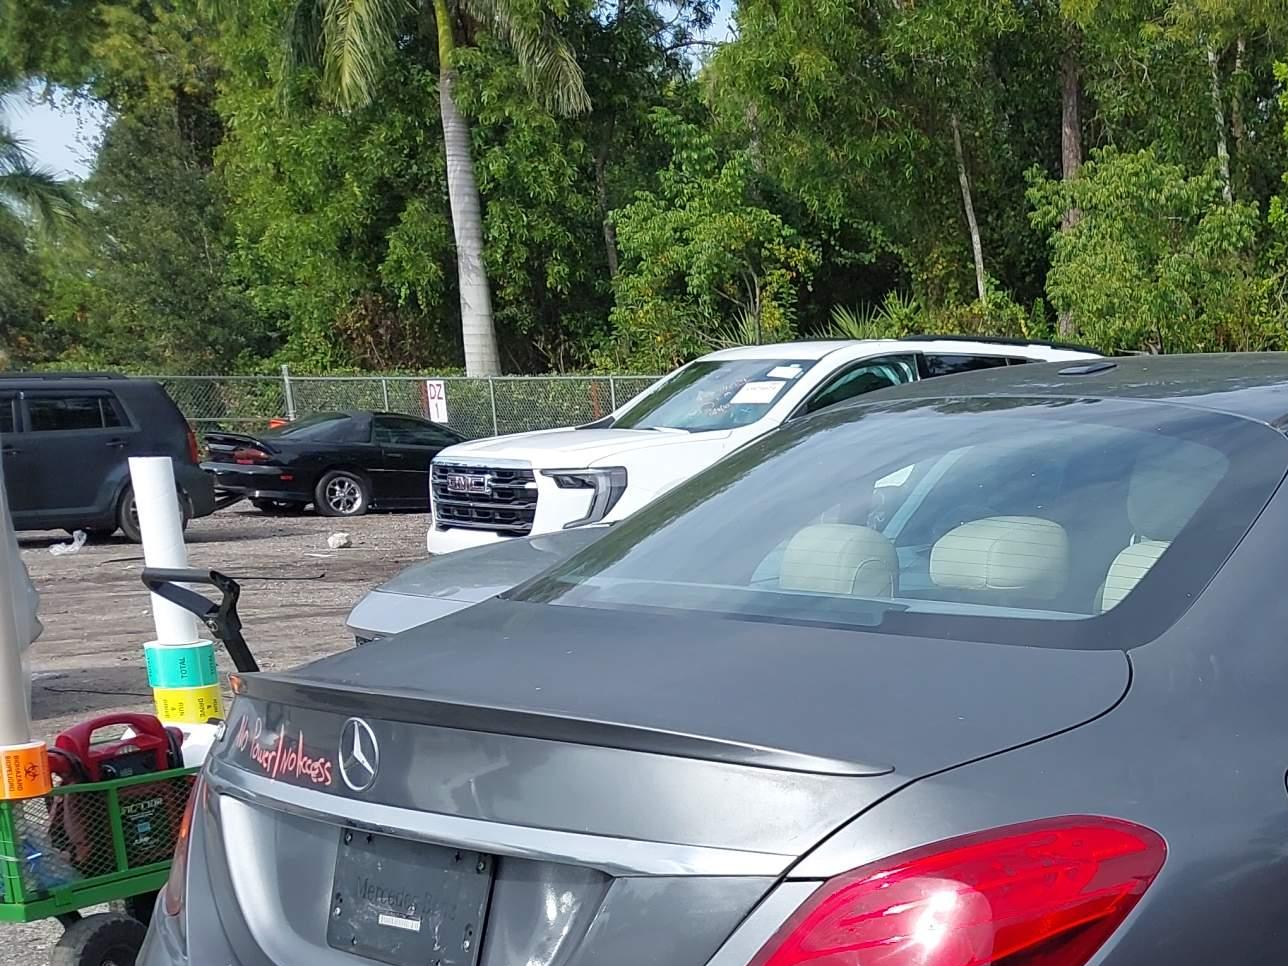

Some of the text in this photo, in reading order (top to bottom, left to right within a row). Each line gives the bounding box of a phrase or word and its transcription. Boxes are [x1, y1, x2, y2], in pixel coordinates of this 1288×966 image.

[429, 383, 444, 400] DZ
[447, 474, 486, 493] GMC
[178, 656, 189, 679] TOTAL
[236, 714, 250, 752] No
